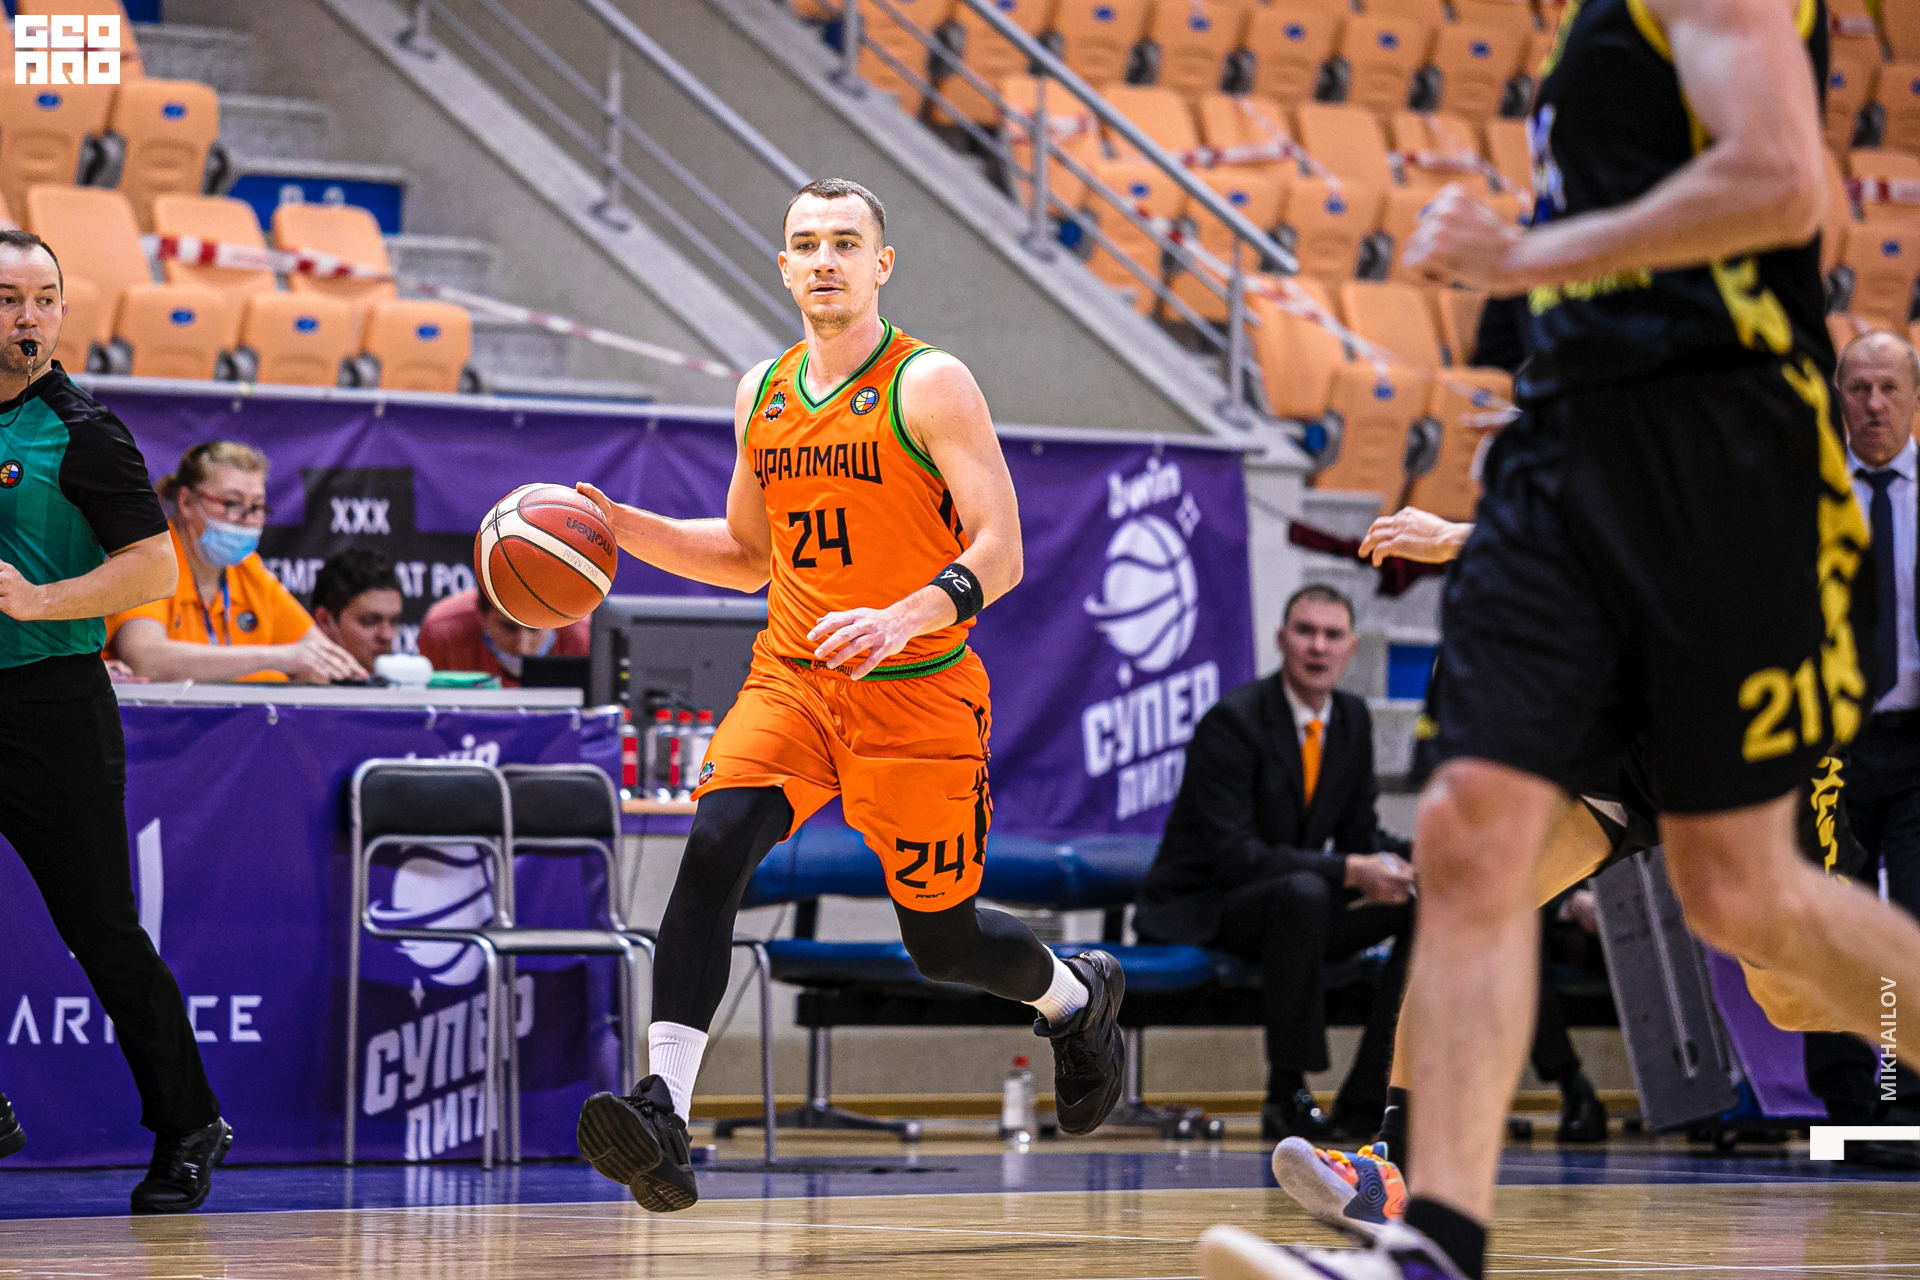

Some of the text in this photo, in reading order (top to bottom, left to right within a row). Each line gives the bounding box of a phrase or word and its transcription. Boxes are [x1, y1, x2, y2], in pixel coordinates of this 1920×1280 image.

[754, 441, 883, 491] УРАЛМАШ
[330, 497, 391, 535] XXX
[566, 517, 613, 557] molten
[787, 508, 852, 569] 24
[939, 568, 972, 593] 24
[1738, 658, 1822, 762] 21
[896, 831, 965, 889] 24
[7, 994, 262, 1045] ARCE
